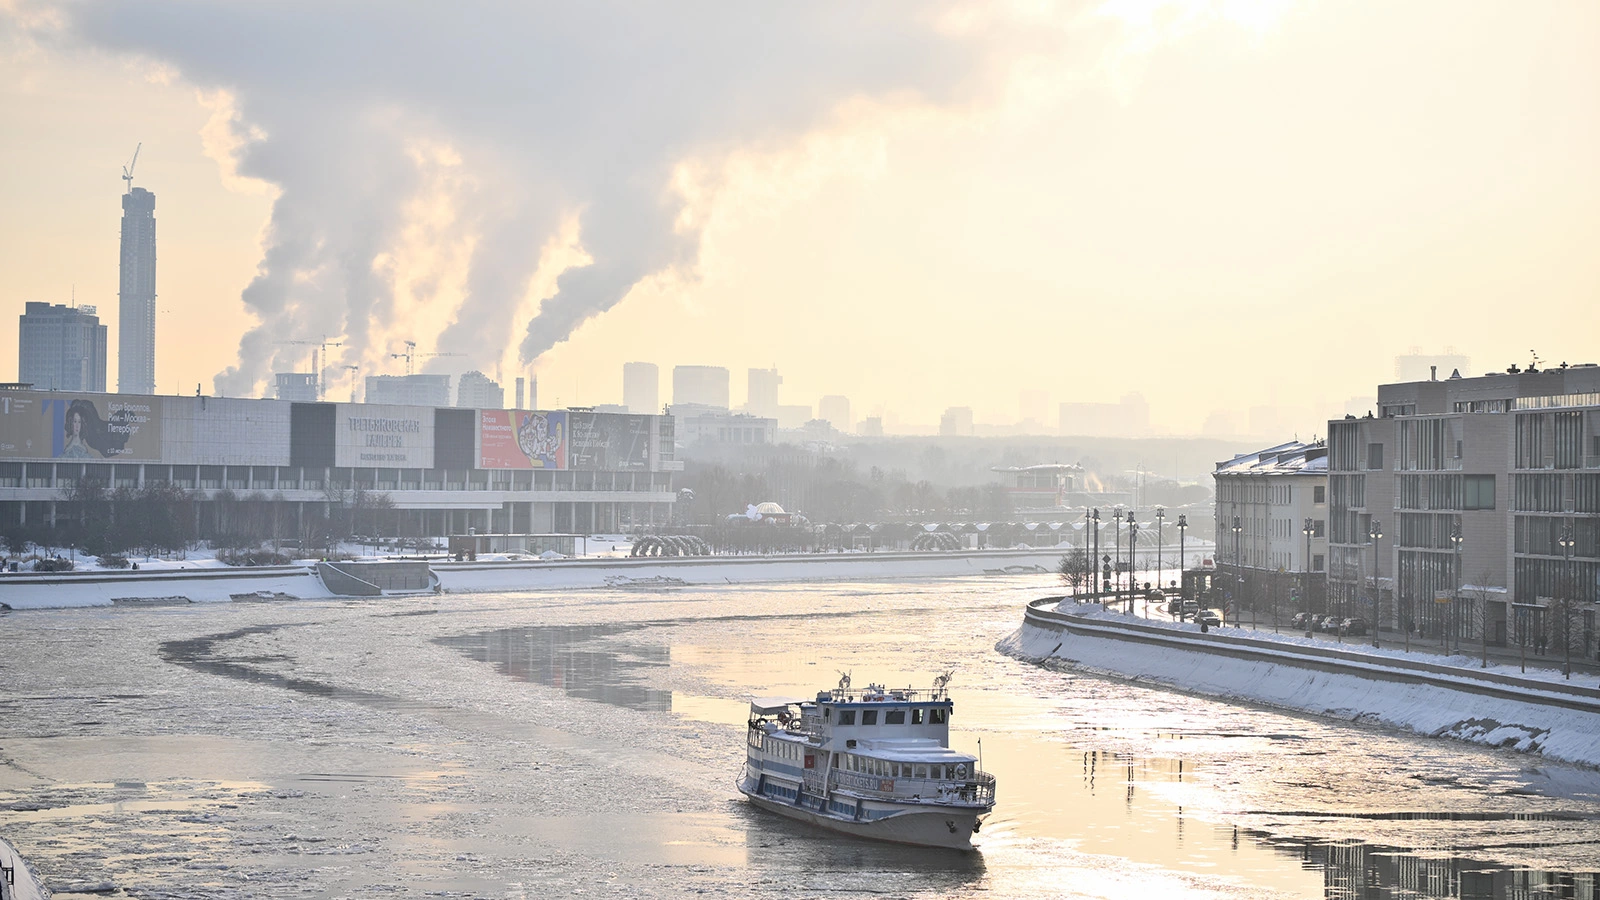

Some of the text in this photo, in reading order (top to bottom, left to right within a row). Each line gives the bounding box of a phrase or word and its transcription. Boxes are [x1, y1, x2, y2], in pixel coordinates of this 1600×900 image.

[108, 401, 123, 412] Карл
[108, 423, 140, 435] Петербург
[348, 417, 420, 433] ТРЕТЬЯКОВСКАЯ
[366, 433, 402, 448] ГАЛЕРЕЯ
